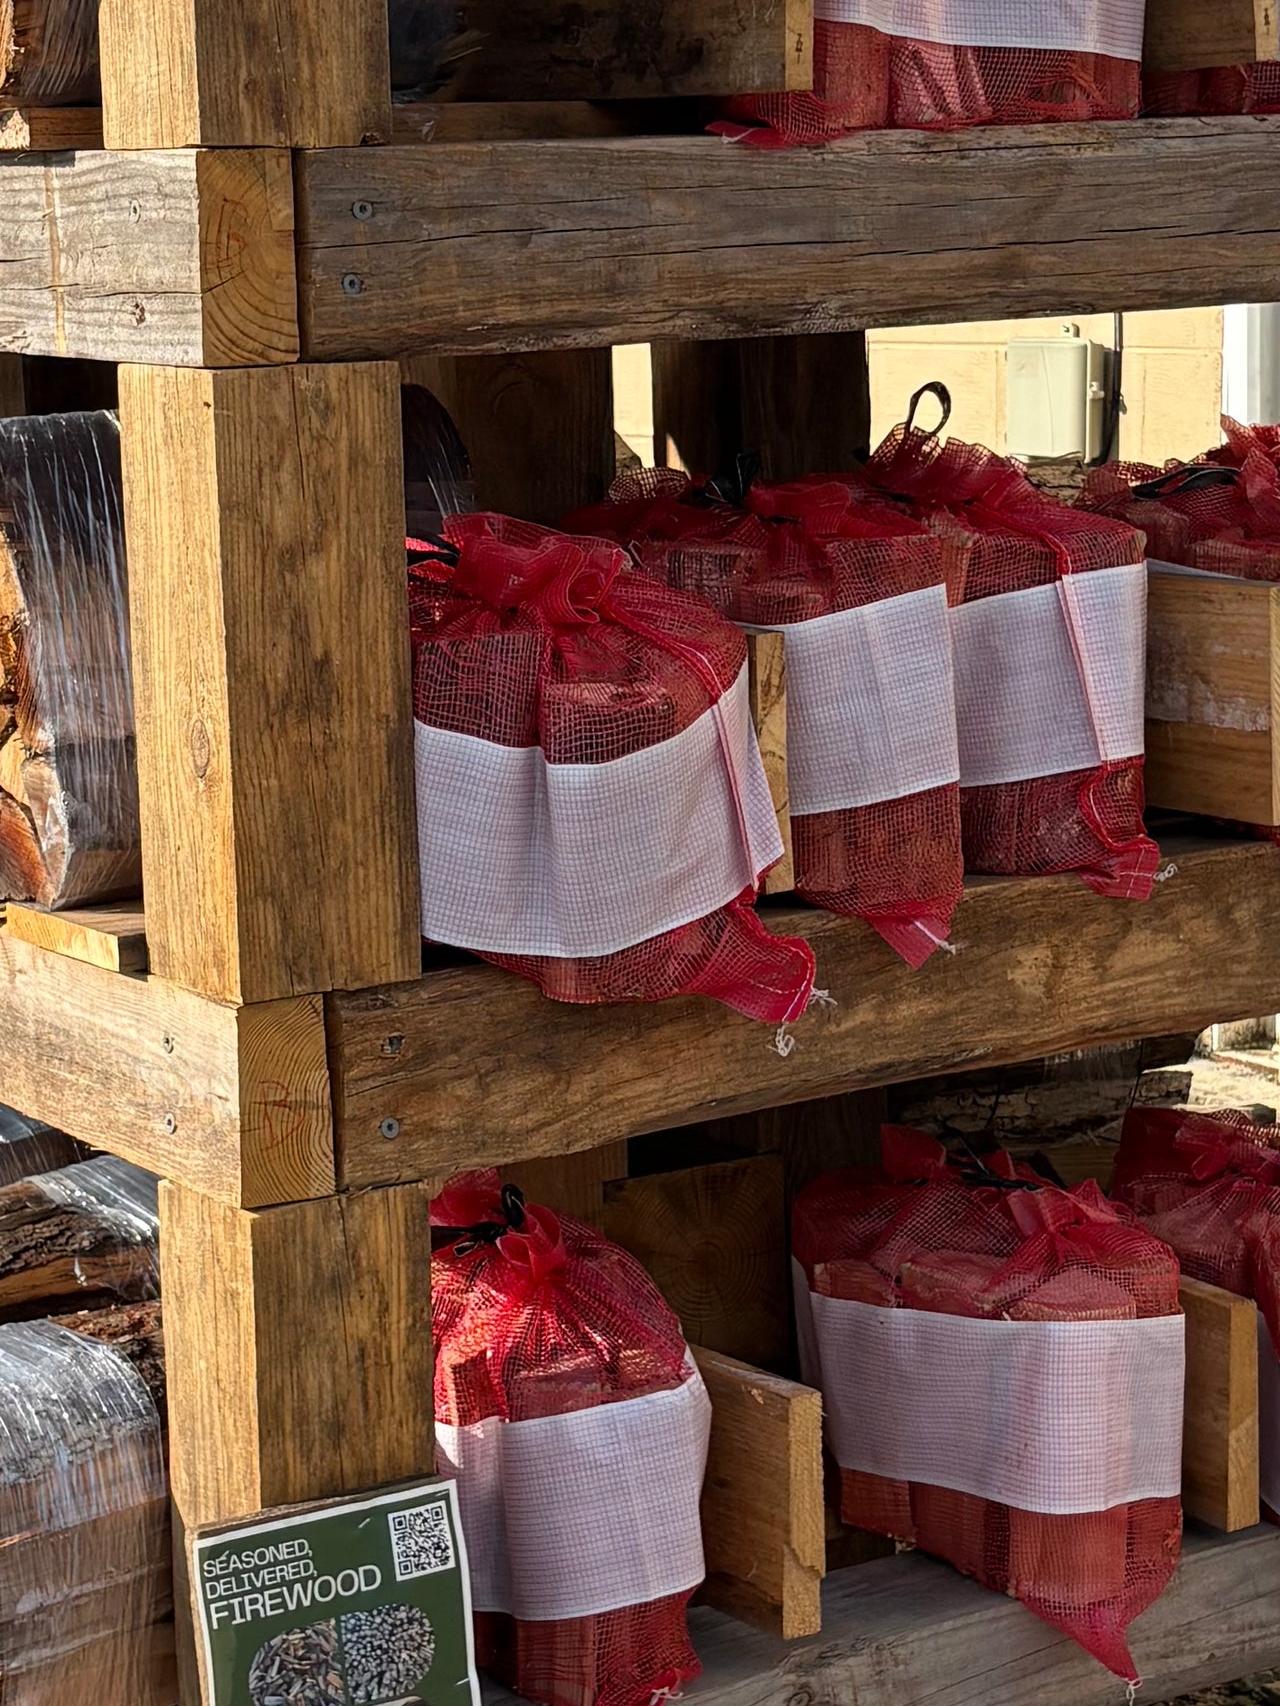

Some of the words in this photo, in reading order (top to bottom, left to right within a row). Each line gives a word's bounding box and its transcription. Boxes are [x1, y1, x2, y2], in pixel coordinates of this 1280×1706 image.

[203, 1539, 313, 1578] SEASONED,
[205, 1559, 317, 1599] DELIVERED,
[210, 1565, 382, 1630] FIREWOOD
